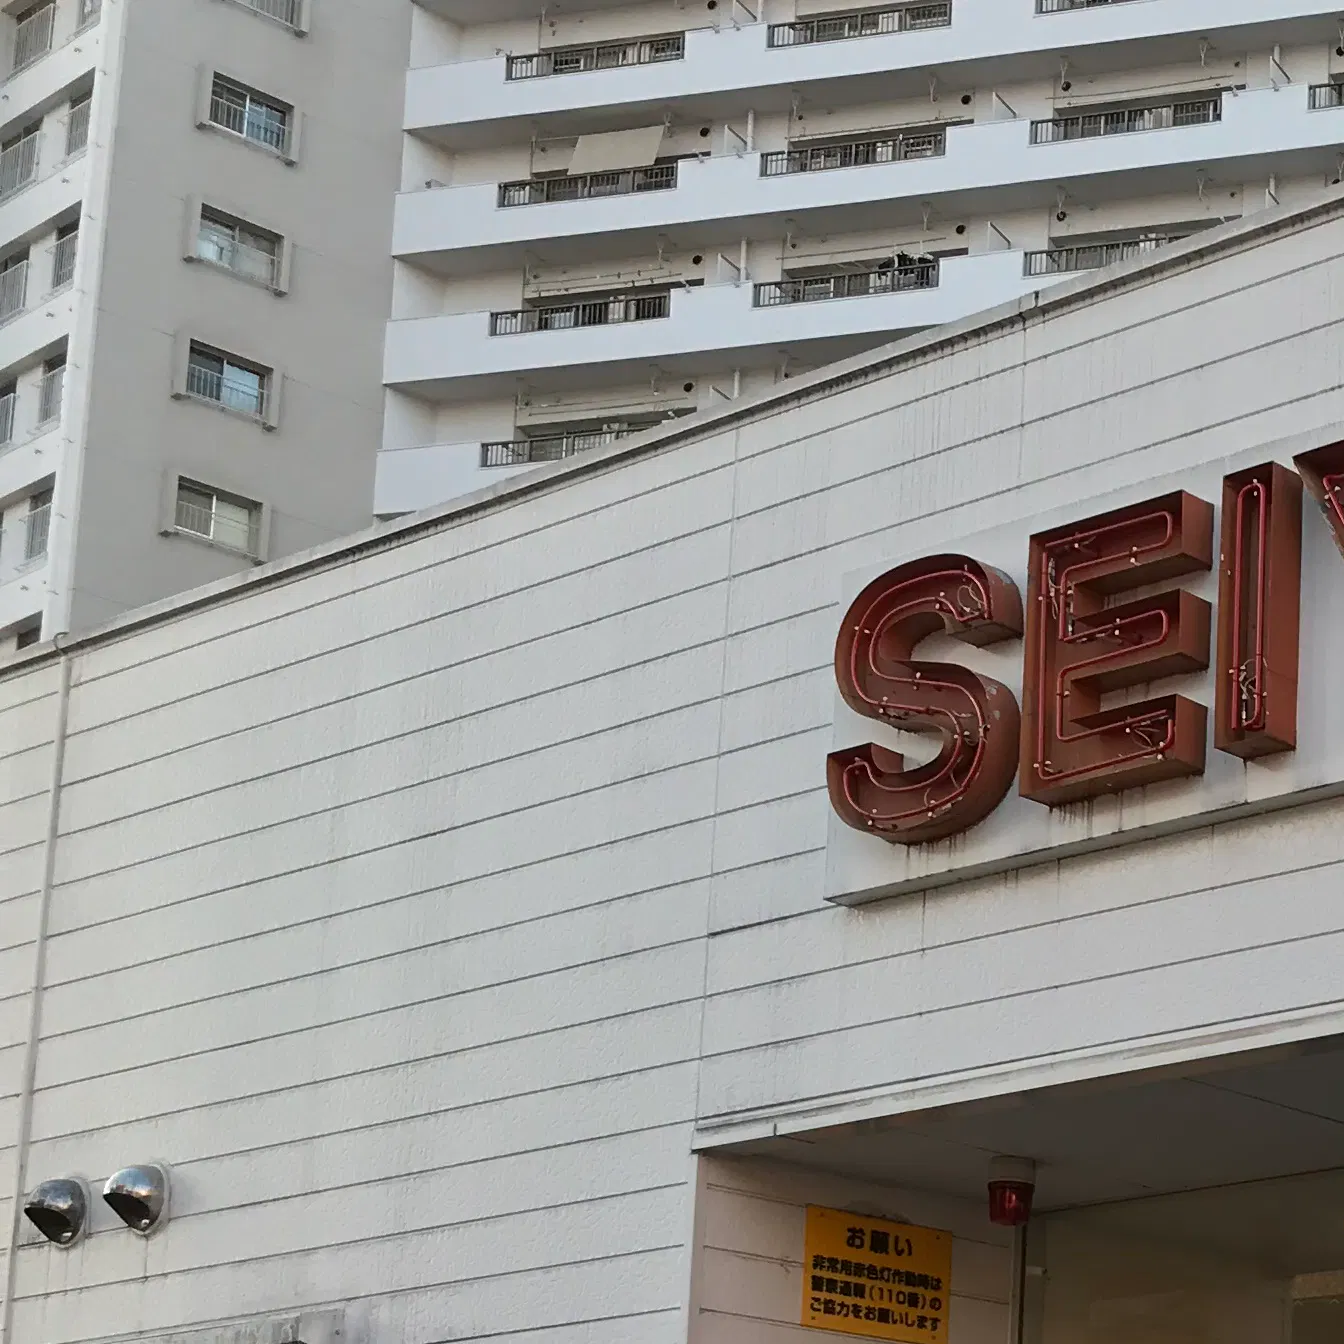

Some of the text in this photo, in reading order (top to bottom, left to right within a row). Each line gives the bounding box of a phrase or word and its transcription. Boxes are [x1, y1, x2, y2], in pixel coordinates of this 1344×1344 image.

[846, 1227, 913, 1256] お願い
[810, 1297, 941, 1331] ご協力をお願いします
